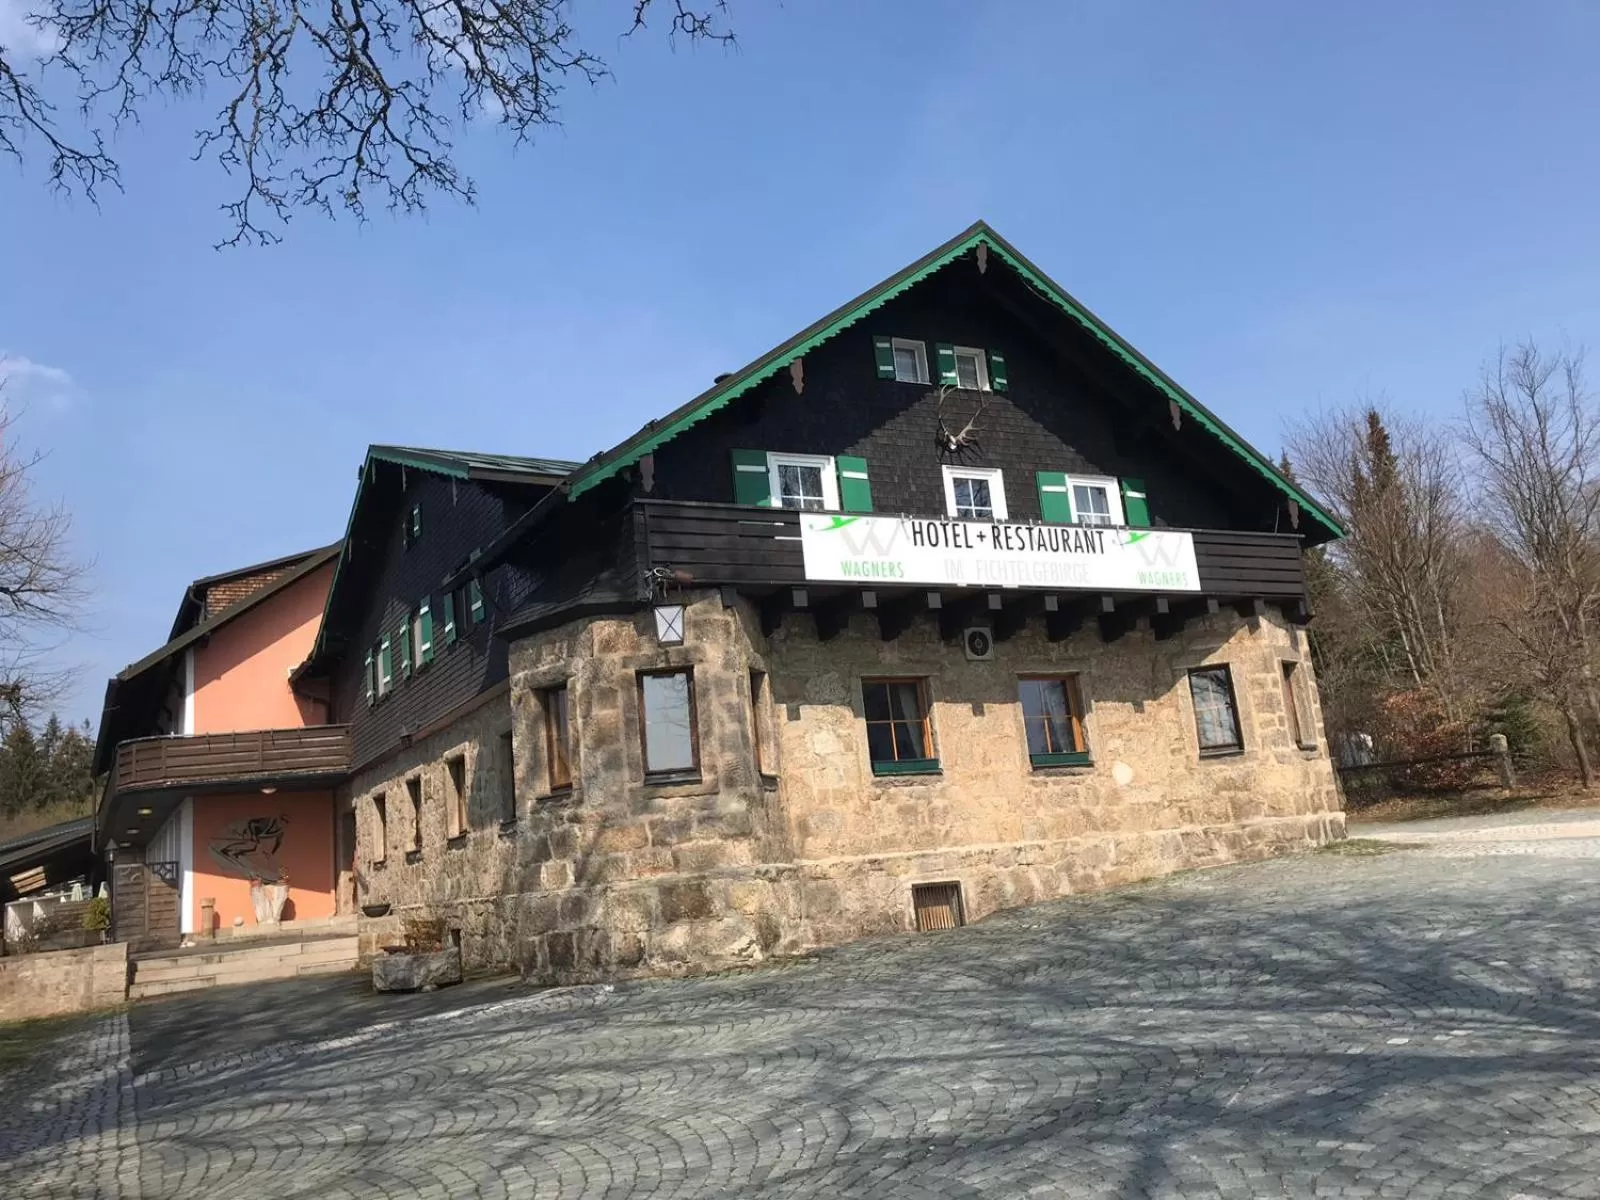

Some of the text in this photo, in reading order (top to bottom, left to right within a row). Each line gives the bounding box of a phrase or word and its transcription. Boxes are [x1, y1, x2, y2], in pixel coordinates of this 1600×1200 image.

[911, 520, 974, 549] HOTEL
[991, 524, 1104, 554] RESTAURANT
[840, 560, 904, 578] WAGNERS
[944, 559, 1089, 584] IM FICHTELGEBIRGE
[1138, 571, 1189, 587] WAGNERS
